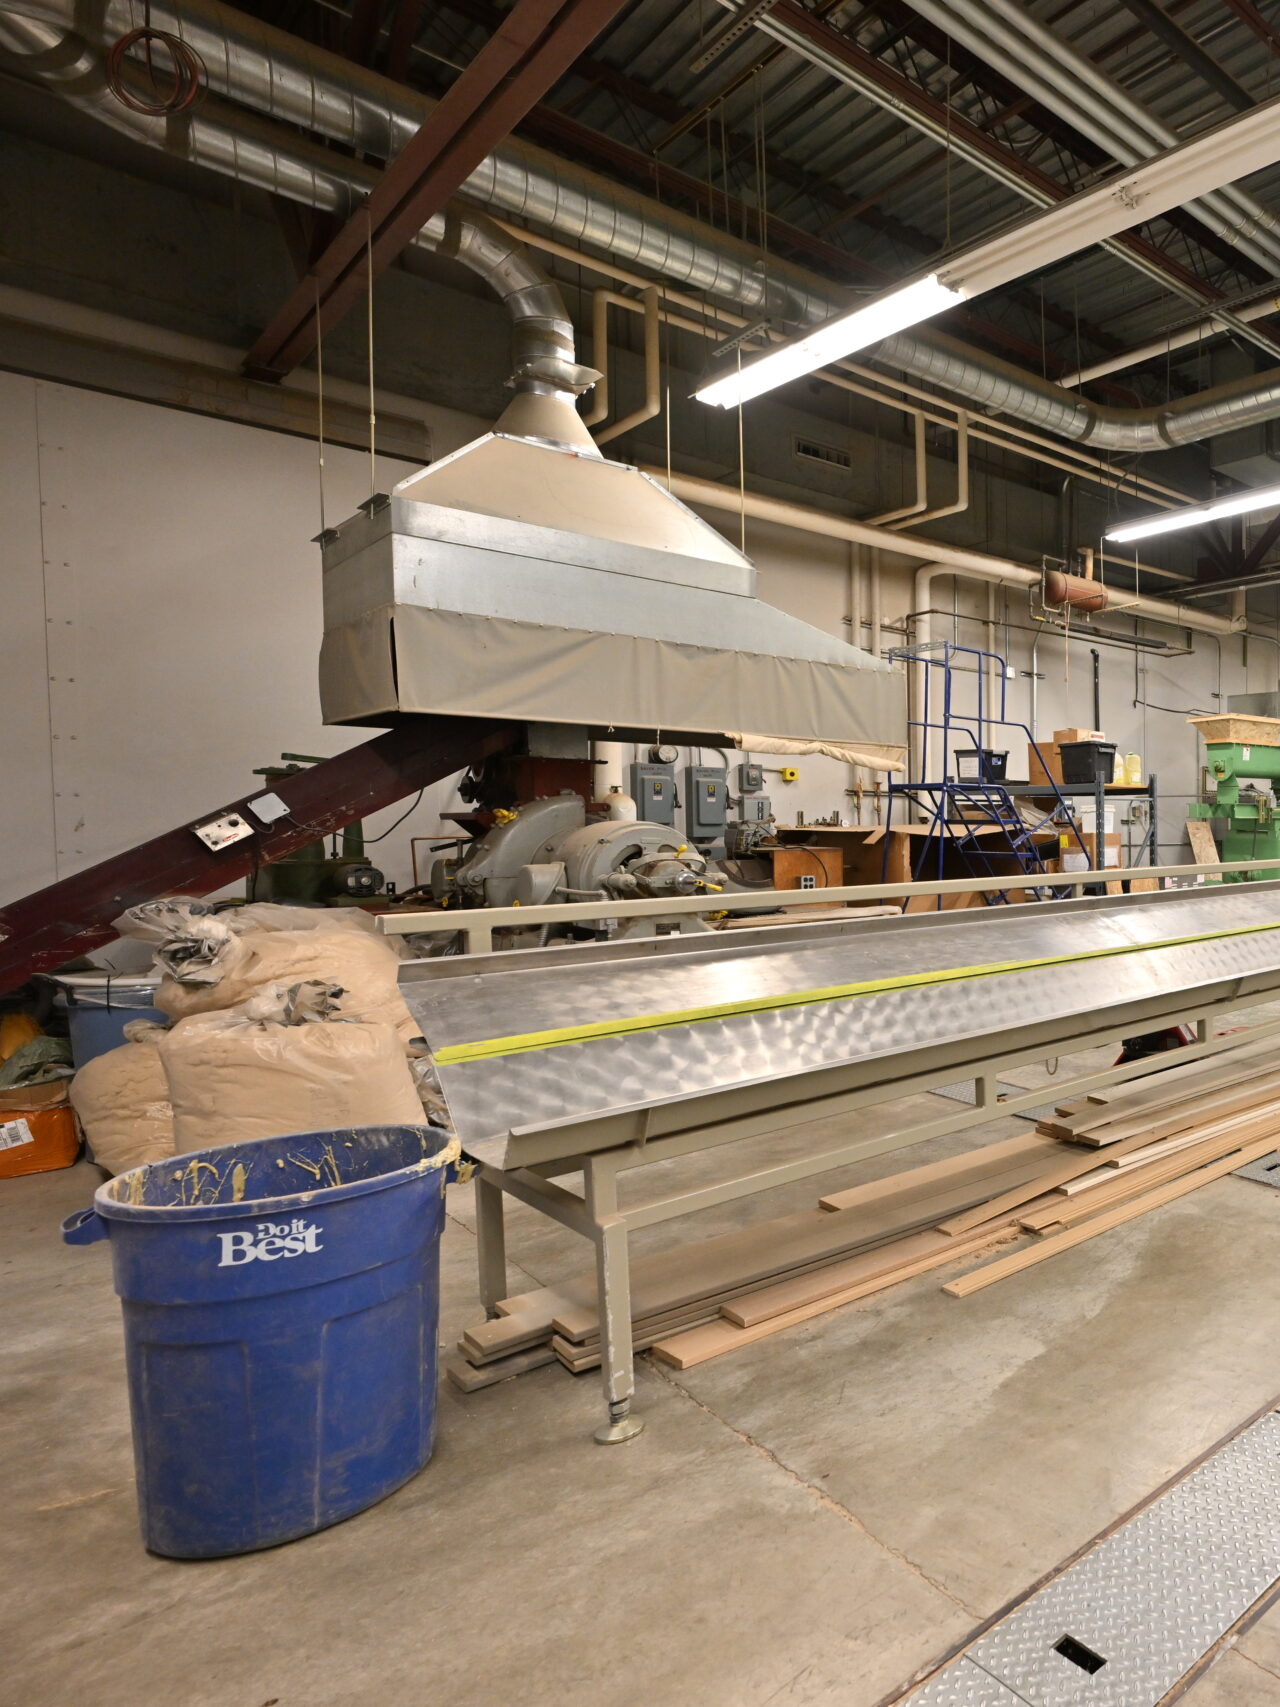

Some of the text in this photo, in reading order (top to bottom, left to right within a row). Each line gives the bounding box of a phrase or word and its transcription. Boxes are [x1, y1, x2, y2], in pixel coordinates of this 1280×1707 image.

[255, 1218, 308, 1240] Do it
[216, 1224, 324, 1267] Best
